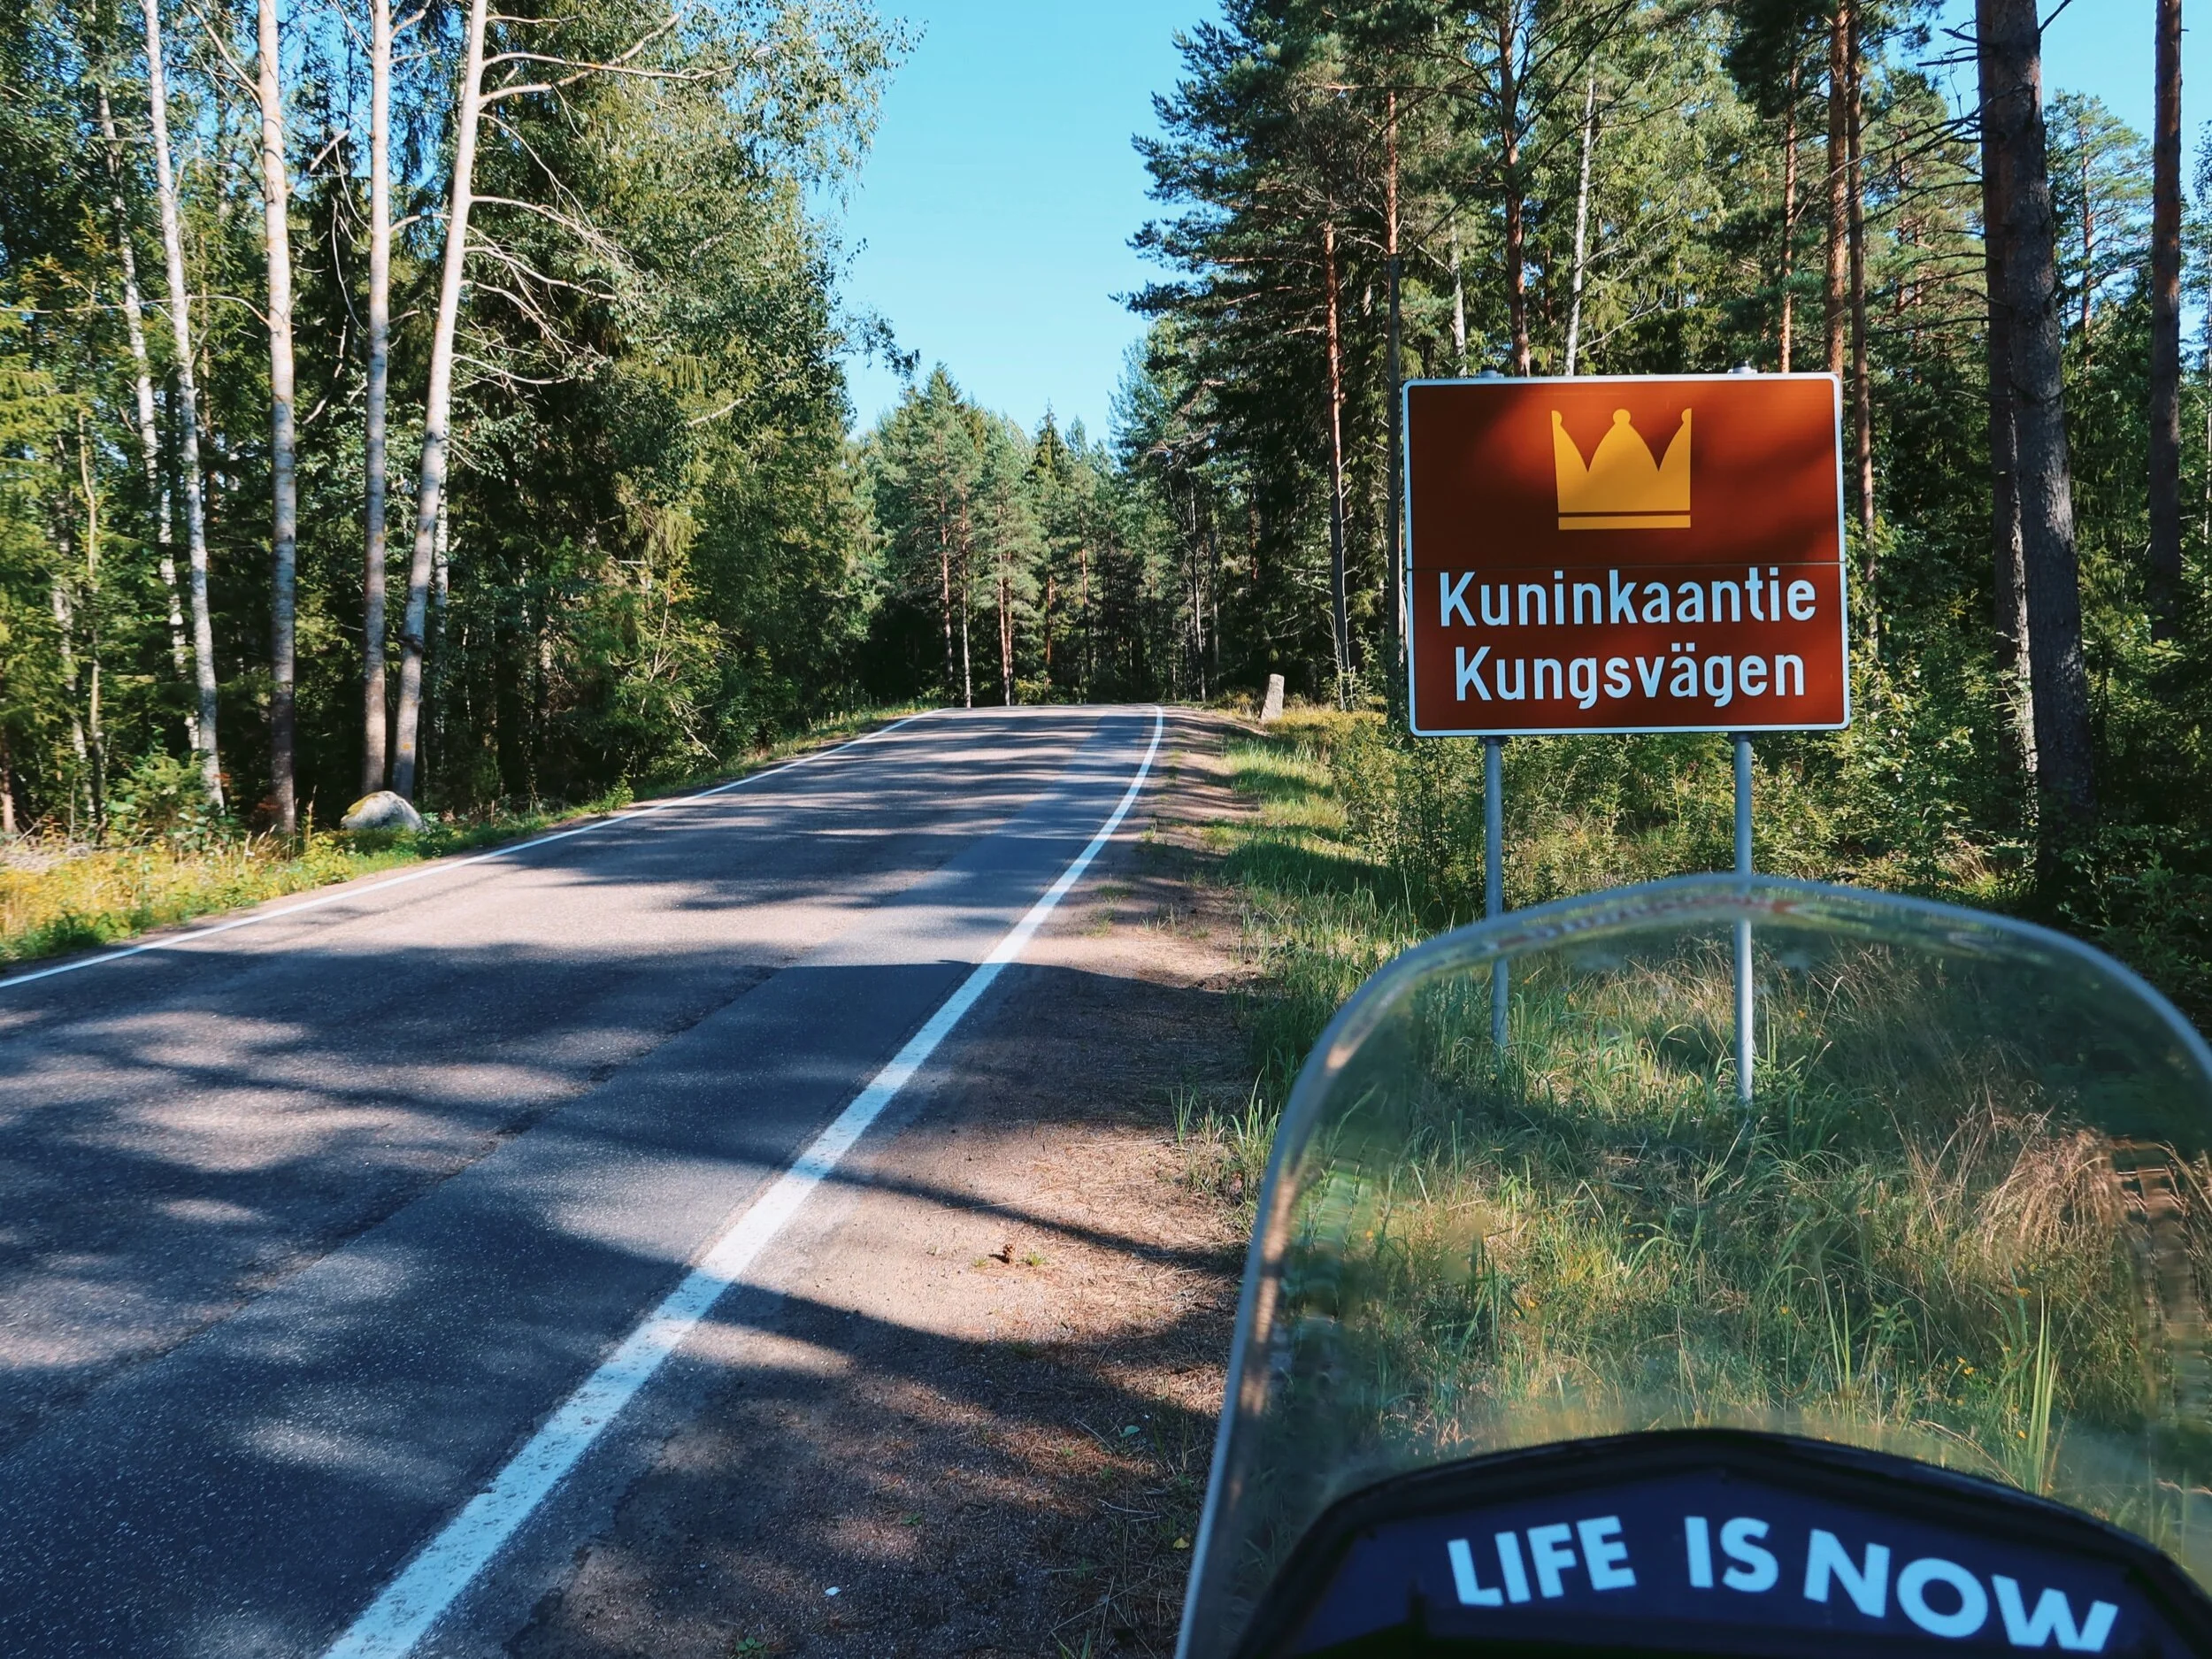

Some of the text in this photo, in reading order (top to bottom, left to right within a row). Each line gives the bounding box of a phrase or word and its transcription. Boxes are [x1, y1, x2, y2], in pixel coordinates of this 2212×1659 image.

[1440, 567, 1816, 627] Kuninkaantie
[1455, 642, 1805, 710] Kungsvägen
[1448, 1516, 2119, 1652] LIFE IS NOW
